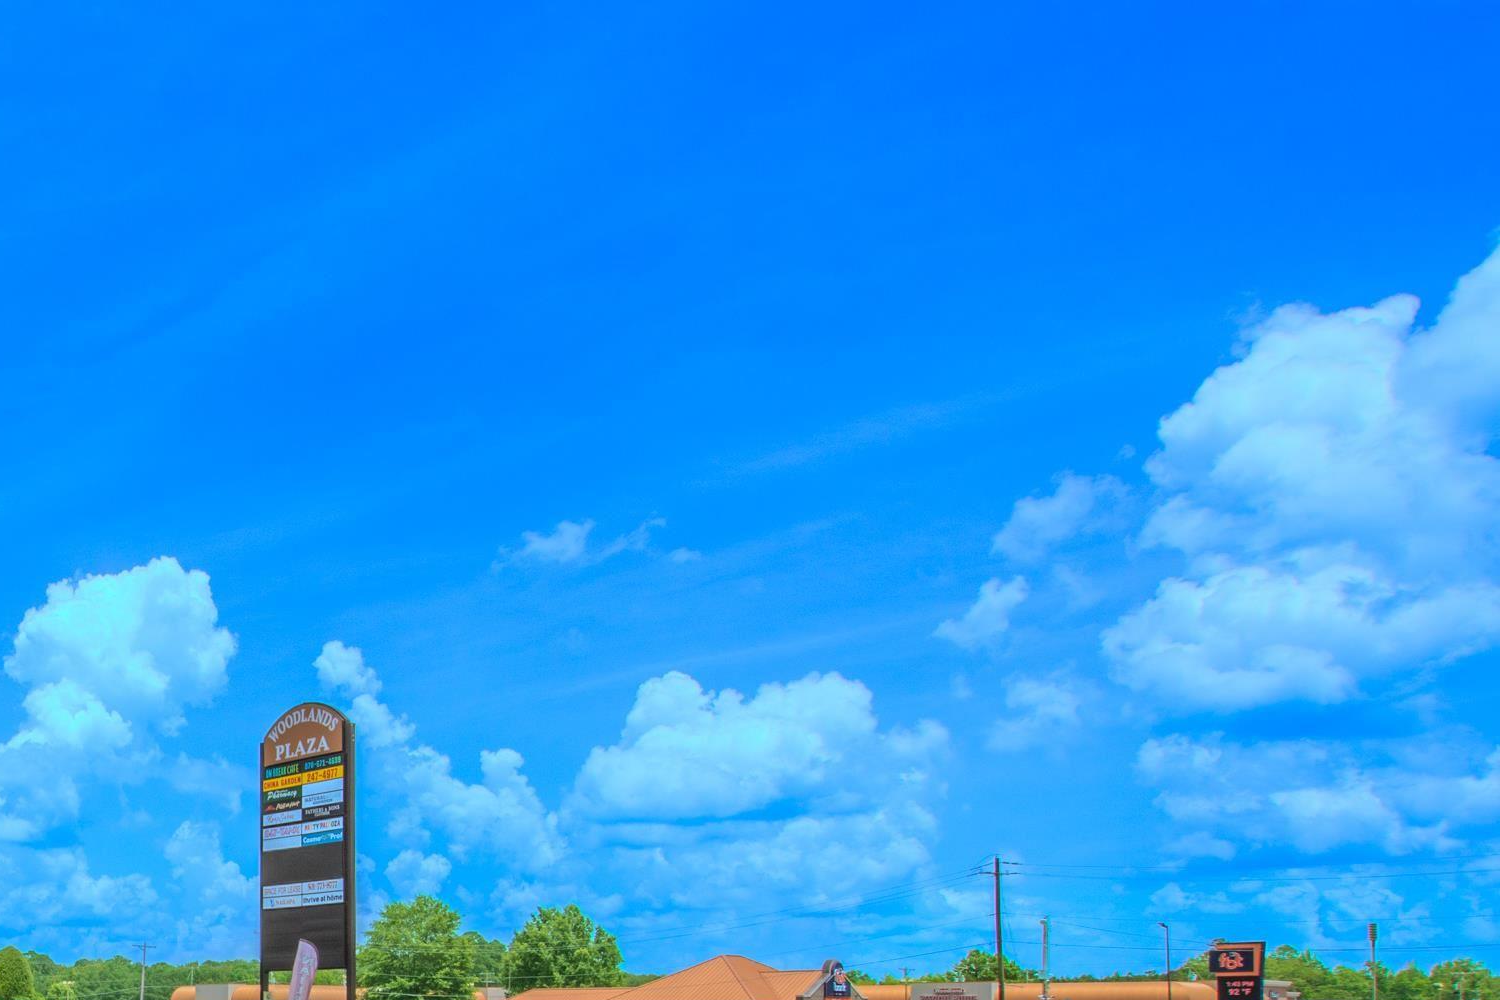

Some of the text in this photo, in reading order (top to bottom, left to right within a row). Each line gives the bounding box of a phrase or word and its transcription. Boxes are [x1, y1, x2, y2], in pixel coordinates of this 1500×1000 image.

[268, 707, 338, 743] WOODLANDS
[275, 735, 330, 761] PLAZA
[306, 768, 338, 782] 247-4977
[263, 776, 301, 789] CHINA GARDEN
[1228, 988, 1240, 996] 92
